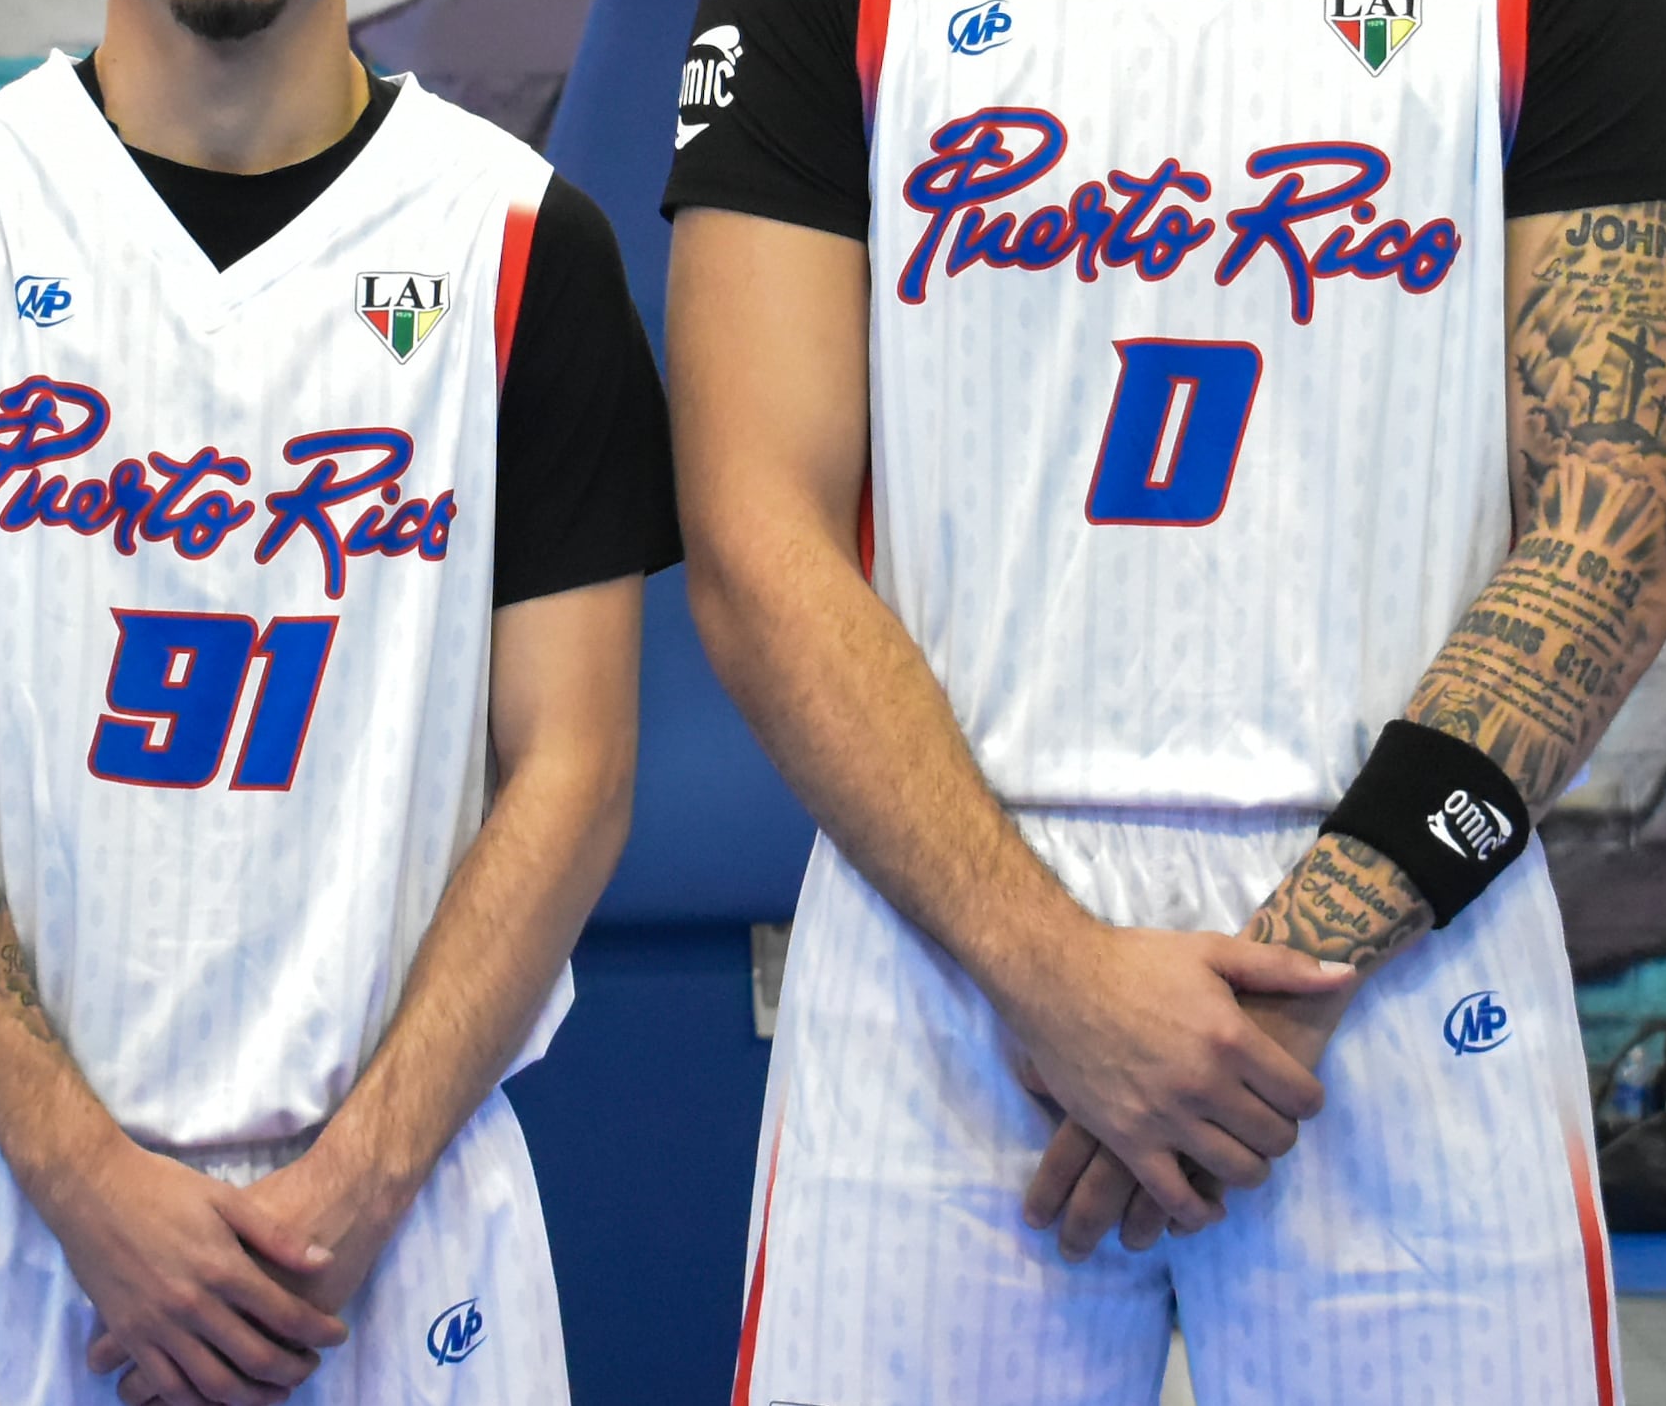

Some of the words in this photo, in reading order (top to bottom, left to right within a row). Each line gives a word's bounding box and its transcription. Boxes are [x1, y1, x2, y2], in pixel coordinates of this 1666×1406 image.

[679, 58, 735, 108] mic
[361, 276, 445, 310] LAI
[898, 106, 1217, 305] Puerto
[1216, 141, 1463, 325] Rico
[254, 426, 458, 600] Rico
[1085, 337, 1264, 528] 0
[87, 607, 340, 791] 91
